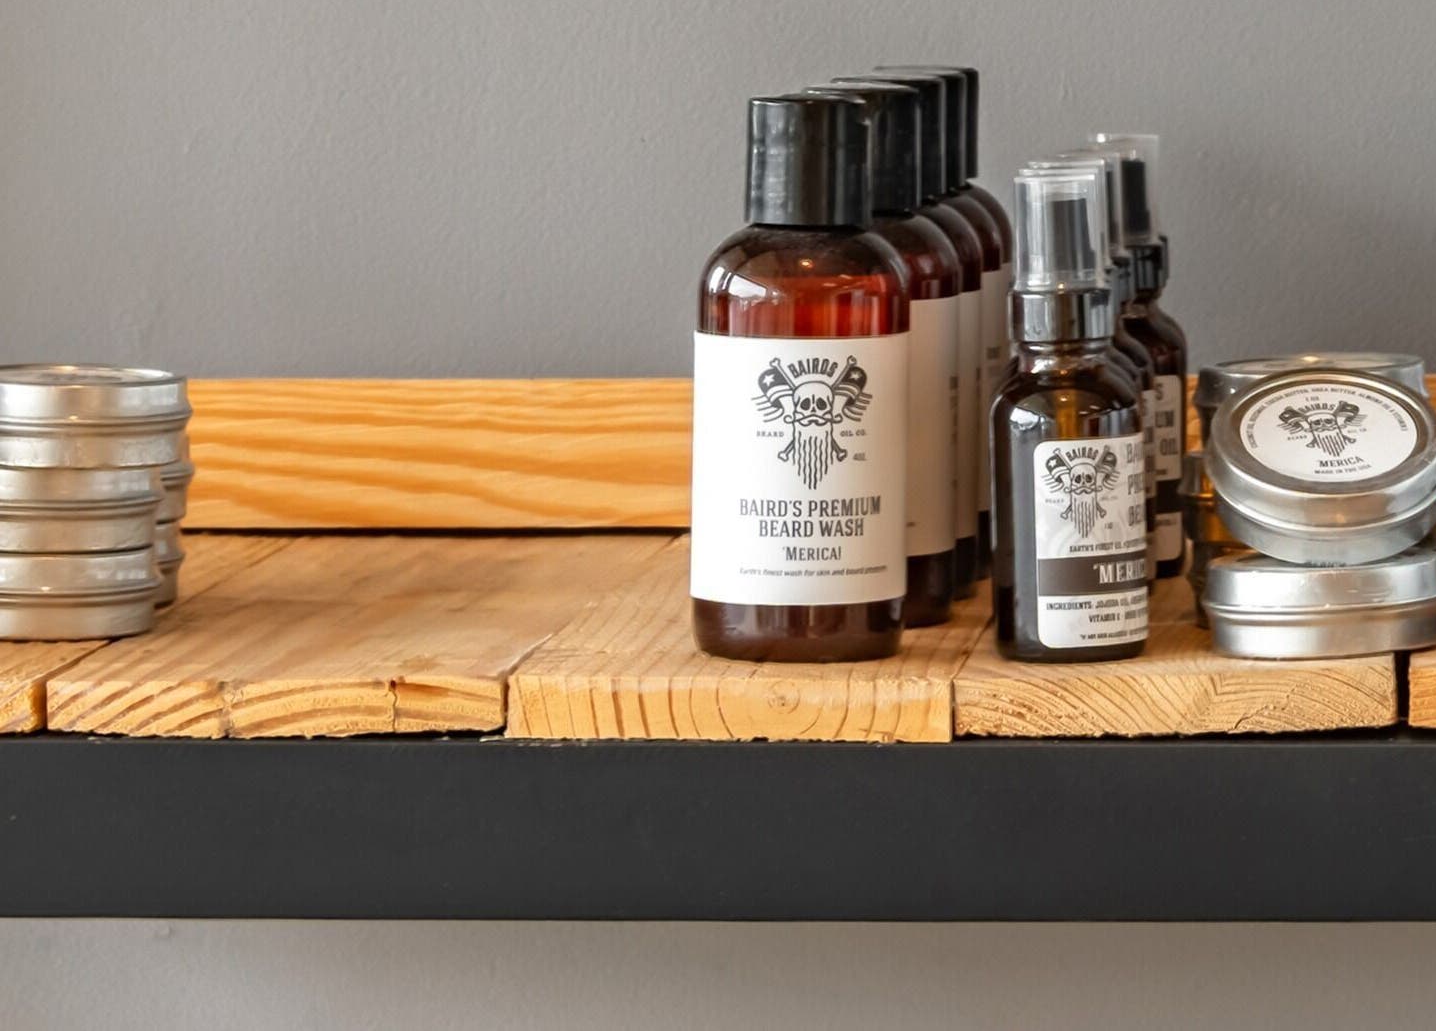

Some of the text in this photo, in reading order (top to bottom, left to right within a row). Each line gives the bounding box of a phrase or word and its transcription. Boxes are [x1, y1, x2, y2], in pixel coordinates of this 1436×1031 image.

[787, 357, 838, 378] BAIRDS
[1066, 446, 1098, 462] BAIRDS
[740, 496, 881, 517] BAIRD'S PREMIUM
[759, 518, 864, 537] BEARD WASH
[782, 546, 842, 561] 'MERICA!
